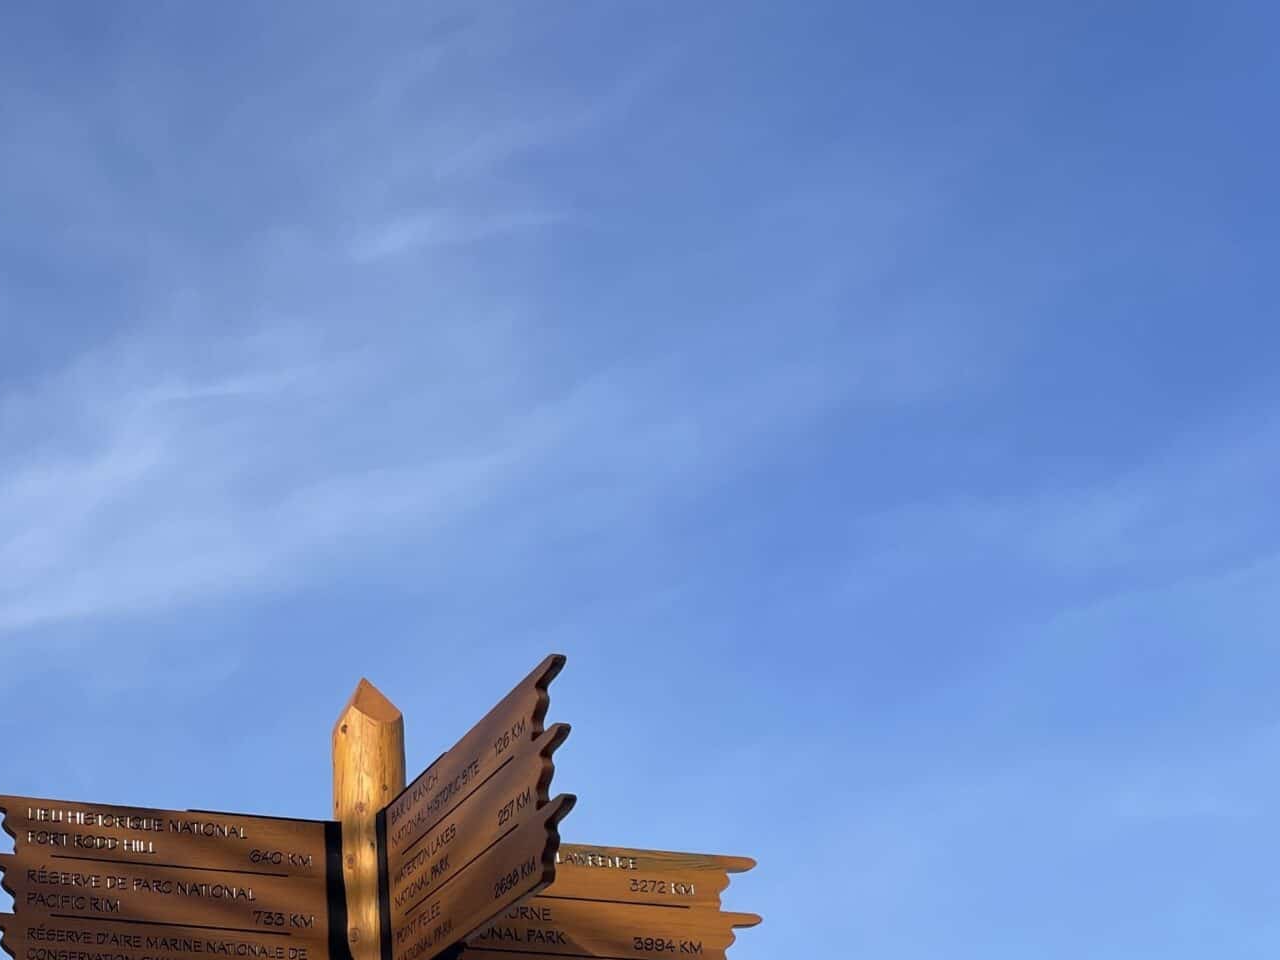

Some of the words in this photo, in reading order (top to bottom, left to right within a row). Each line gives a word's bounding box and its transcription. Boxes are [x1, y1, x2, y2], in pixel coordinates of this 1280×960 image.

[391, 808, 426, 847] NATIONAL
[427, 776, 461, 816] HISTORIC
[461, 758, 480, 785] SITE
[493, 731, 510, 757] 126
[510, 716, 526, 745] KM
[26, 807, 63, 823] LIEU
[67, 810, 164, 833] HISTORIQUE
[169, 819, 248, 840] NATIONAL
[26, 830, 69, 847] FORT
[73, 833, 120, 850] RODD
[123, 839, 157, 854] HILL
[248, 848, 283, 866] 640
[287, 853, 313, 867] KM
[393, 846, 432, 888] WATERTON
[431, 823, 457, 857] LAKES
[394, 872, 430, 908] NATIONAL
[431, 854, 450, 880] PARK
[497, 799, 515, 827] 257
[516, 786, 531, 811] KM
[555, 851, 638, 870] LAWRENCE
[26, 865, 101, 889] RÉSERVE
[106, 875, 128, 890] DE
[133, 879, 173, 894] PARC
[176, 880, 256, 901] NATIONAL
[520, 855, 537, 880] KM
[629, 878, 666, 894] 3272
[671, 881, 695, 895] KM
[26, 892, 86, 910] PACIFIC
[89, 897, 121, 913] RIM
[253, 910, 285, 926] 733
[289, 911, 315, 928] KM
[396, 918, 417, 945] POINT
[418, 900, 441, 929] PELEE
[26, 923, 93, 944] RÉSERVE
[96, 932, 142, 948] D'AIRE
[146, 936, 202, 953] MARINE
[206, 942, 285, 959] NATIONALE
[288, 947, 308, 960] DE
[526, 929, 567, 945] PARK
[679, 939, 704, 954] KM
